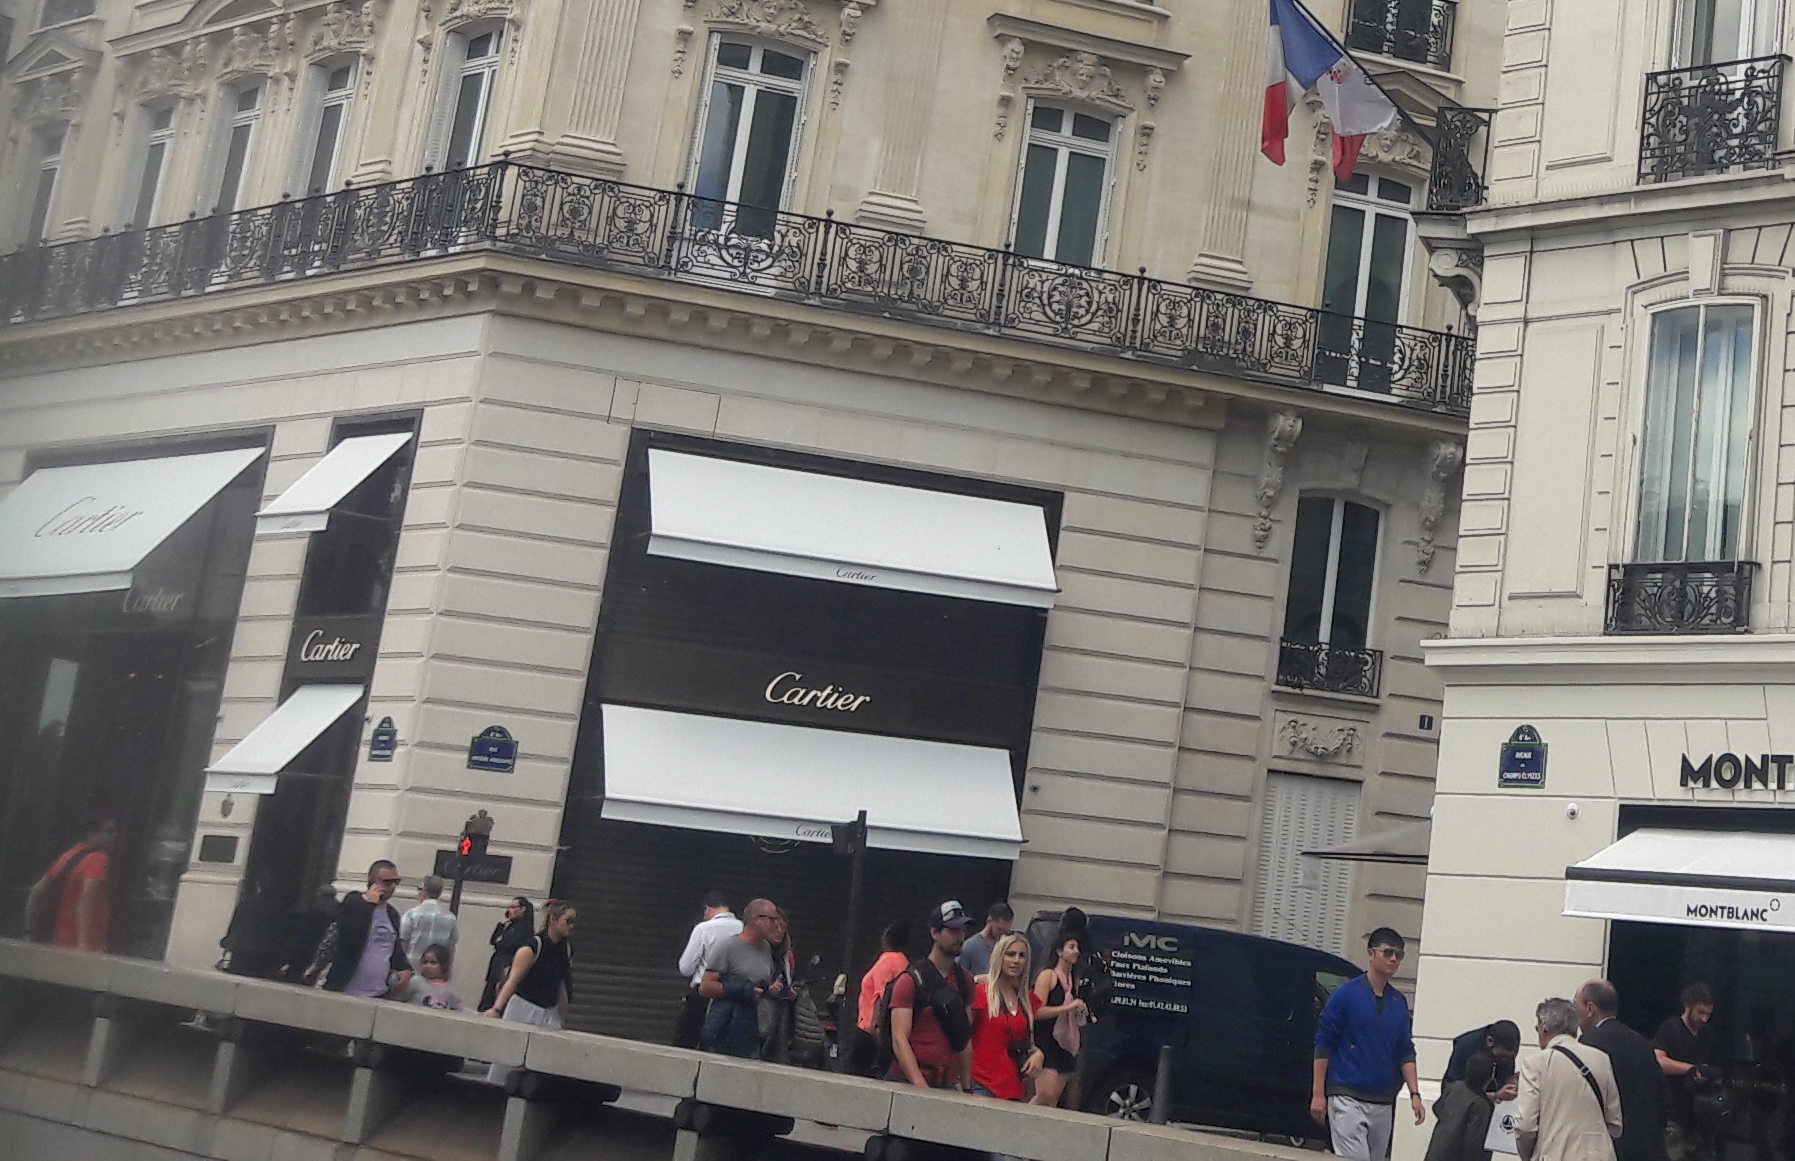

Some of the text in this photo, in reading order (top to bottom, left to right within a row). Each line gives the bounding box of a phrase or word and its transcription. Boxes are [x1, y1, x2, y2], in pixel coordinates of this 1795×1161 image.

[34, 495, 145, 538] Cartier
[836, 566, 877, 582] Cartier
[300, 629, 362, 662] Cartier
[764, 671, 871, 712] Cartier
[795, 824, 832, 839] Cartie
[1686, 904, 1768, 922] MONTBLANC
[1111, 950, 1147, 961] Cloisons
